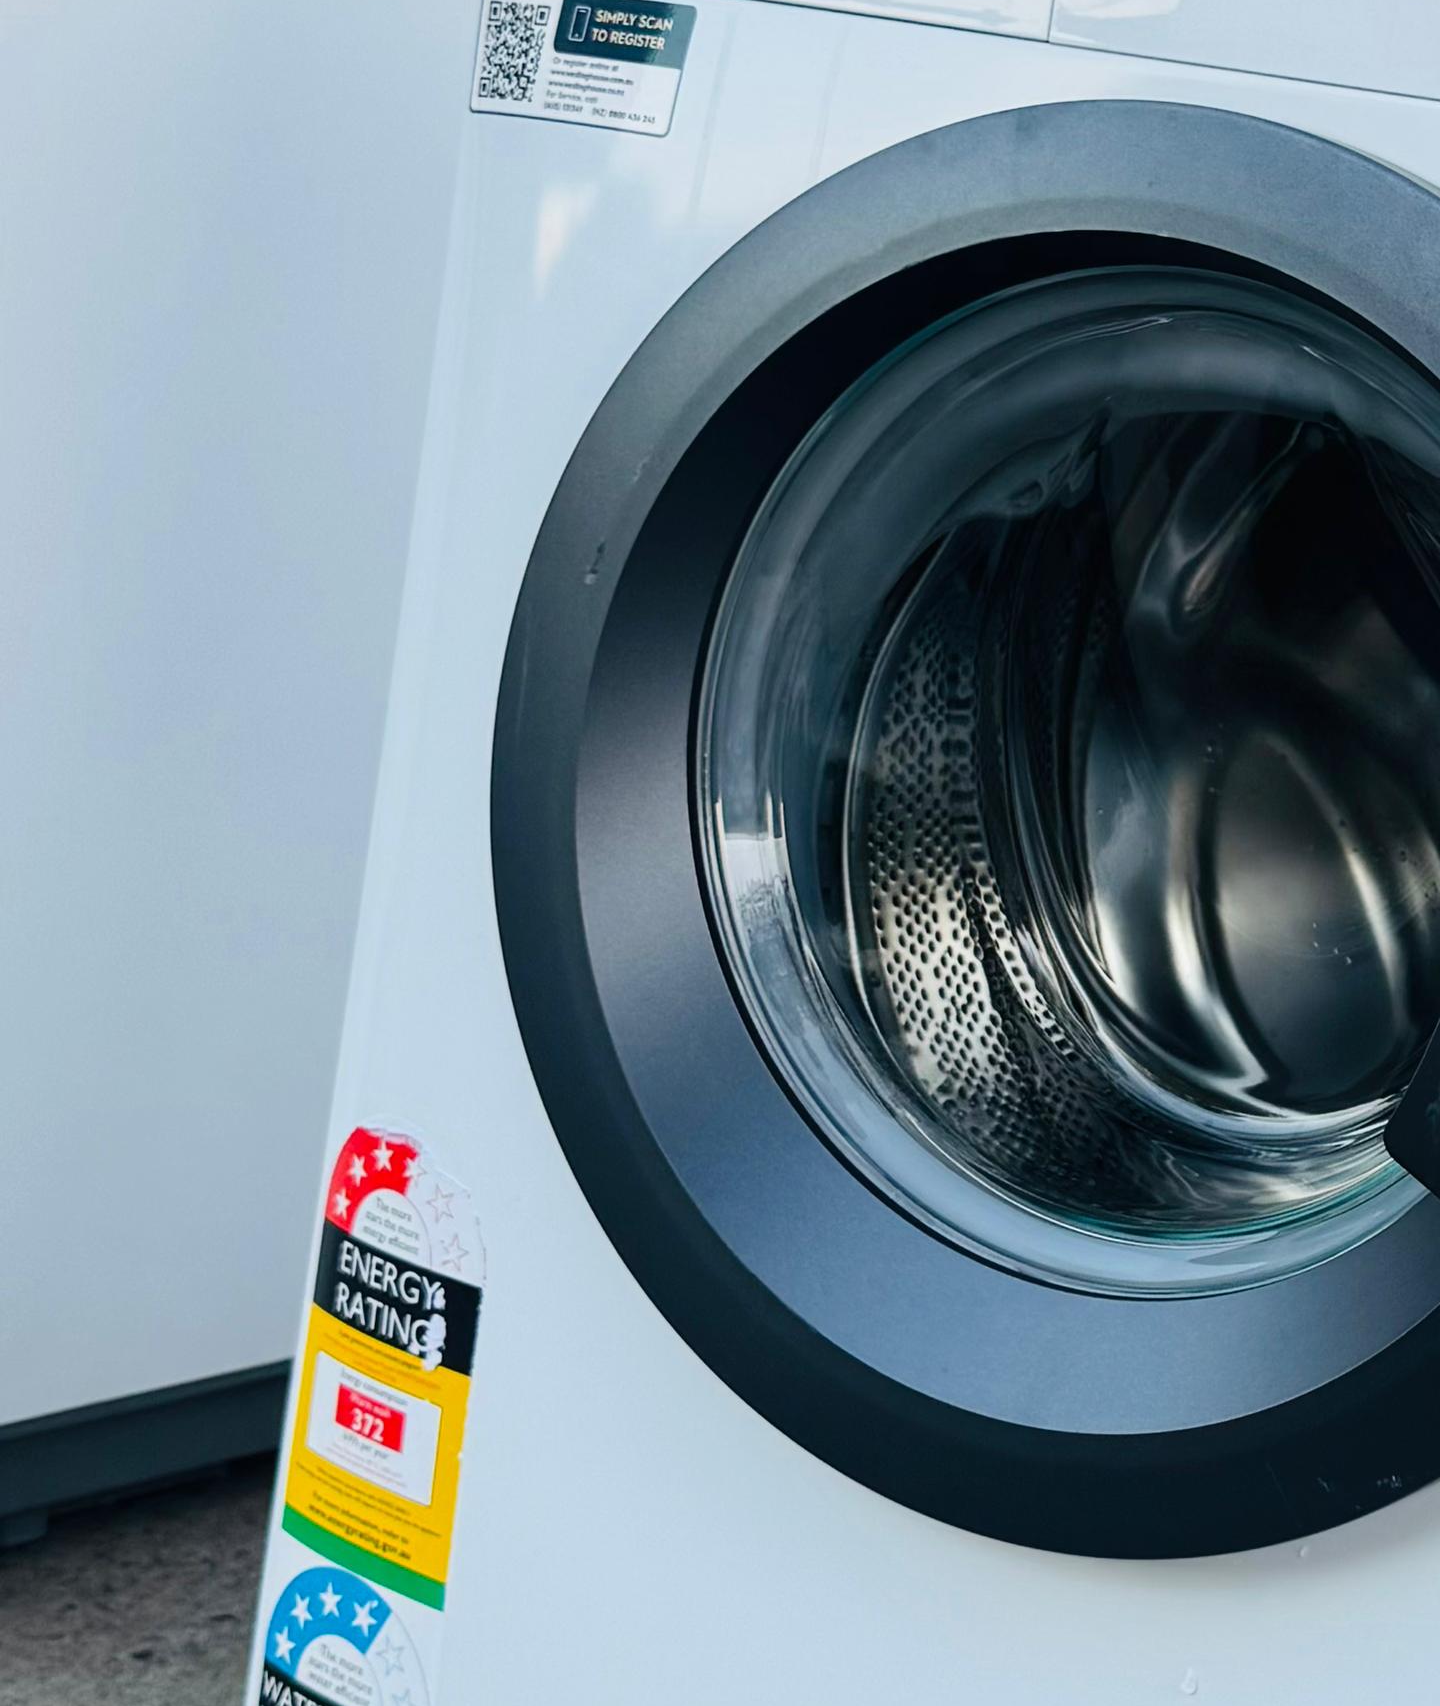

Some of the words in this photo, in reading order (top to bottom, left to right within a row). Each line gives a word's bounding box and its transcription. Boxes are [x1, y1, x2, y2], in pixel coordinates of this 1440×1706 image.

[595, 9, 637, 27] SIMPLY
[638, 14, 674, 31] SCAN
[592, 28, 608, 42] TO
[610, 31, 665, 50] REGISTER
[338, 1240, 441, 1310] ENERGY
[336, 1281, 436, 1353] RATING
[351, 1407, 386, 1443] 372
